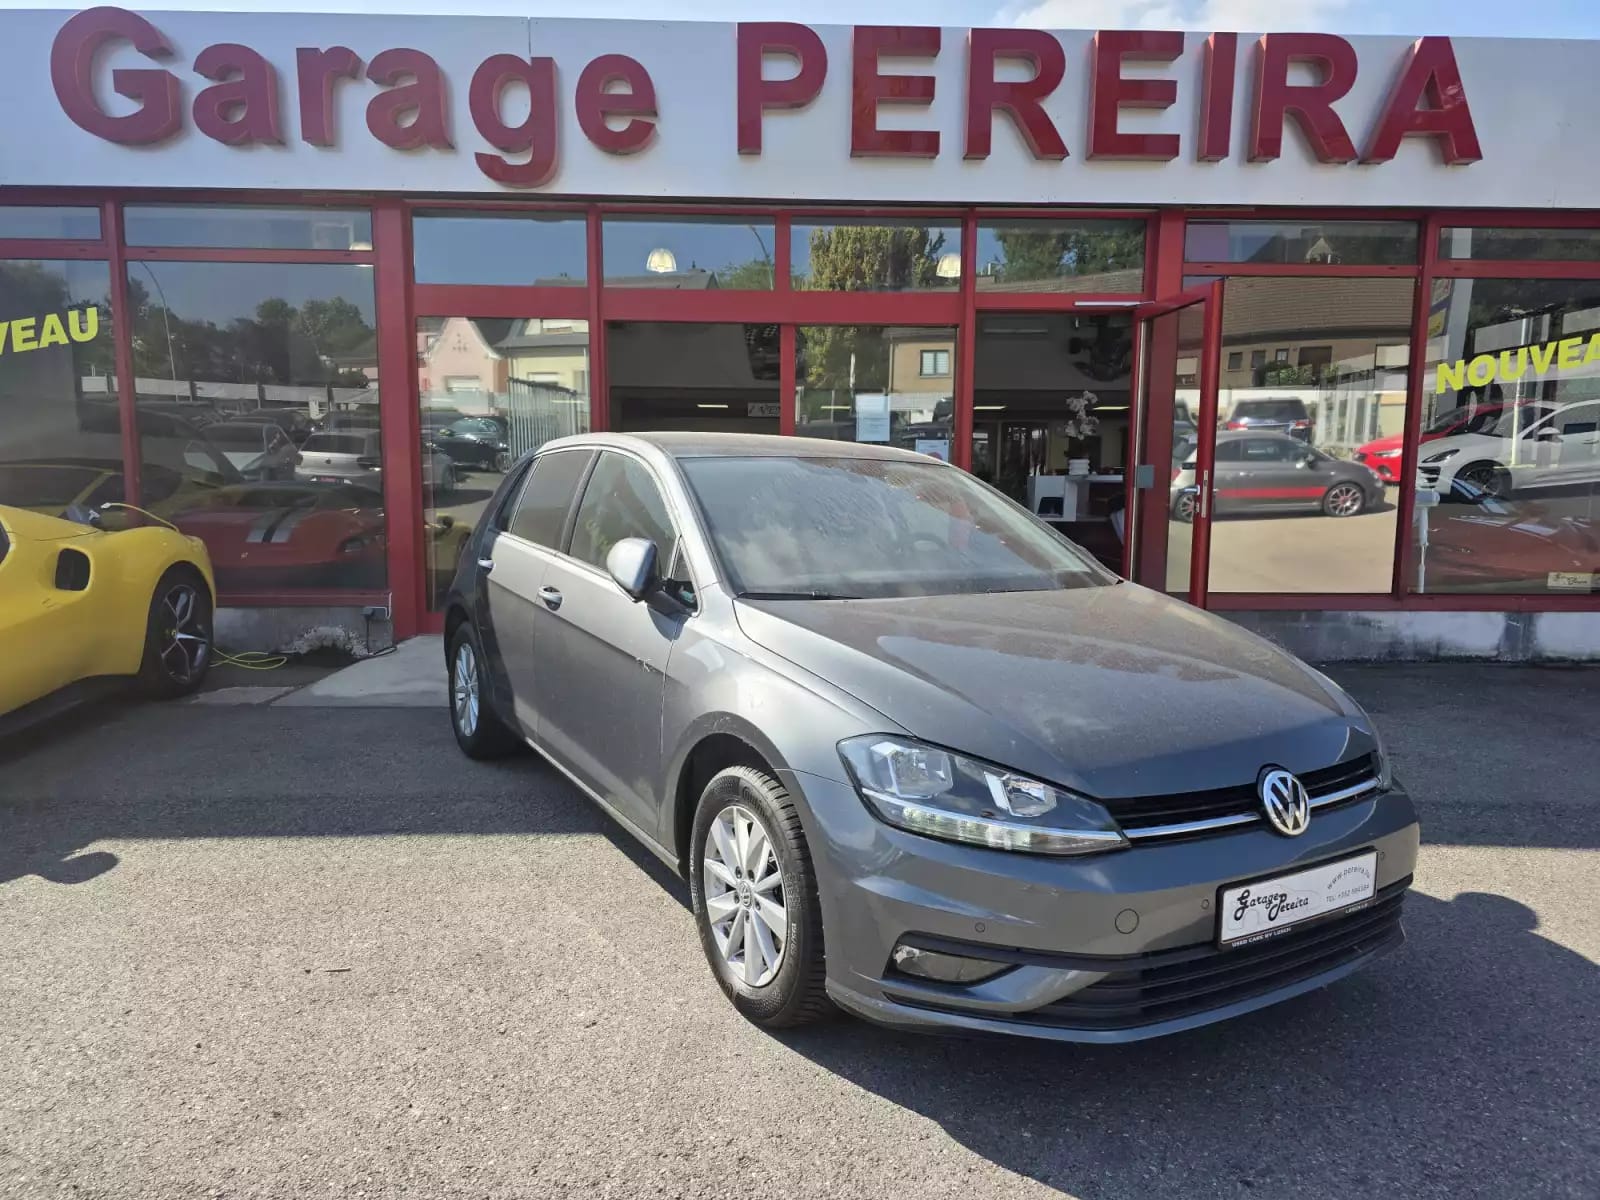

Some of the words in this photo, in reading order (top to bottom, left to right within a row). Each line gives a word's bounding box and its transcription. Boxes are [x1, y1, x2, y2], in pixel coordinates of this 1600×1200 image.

[51, 6, 658, 187] Garage
[738, 22, 1483, 165] PEREIRA
[1234, 889, 1279, 921] Garage
[1268, 893, 1309, 921] Pereira
